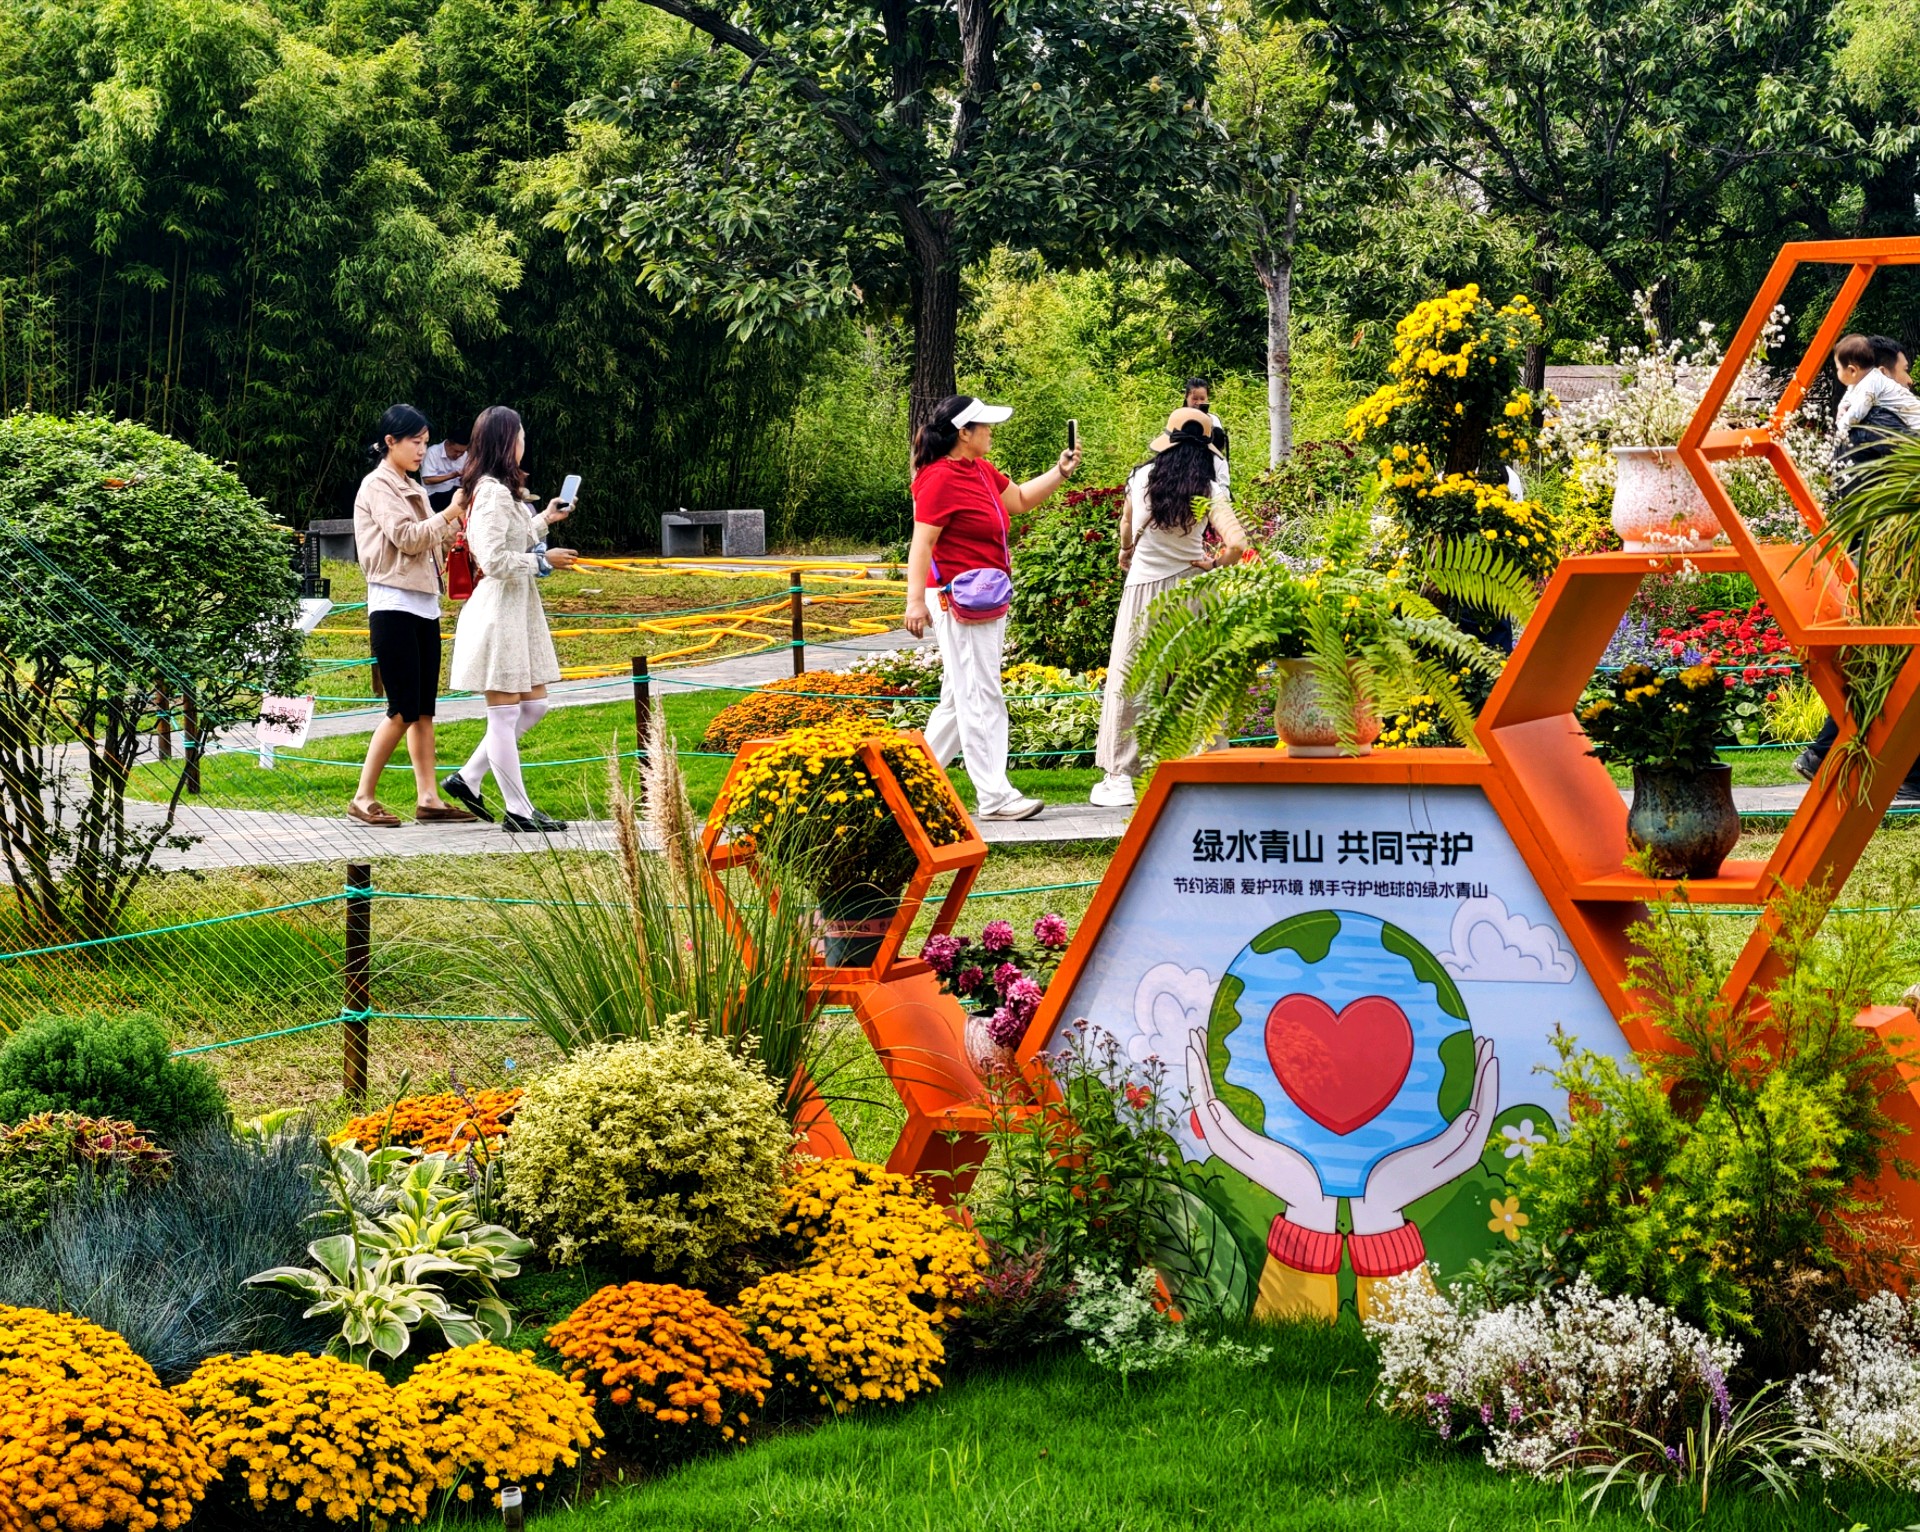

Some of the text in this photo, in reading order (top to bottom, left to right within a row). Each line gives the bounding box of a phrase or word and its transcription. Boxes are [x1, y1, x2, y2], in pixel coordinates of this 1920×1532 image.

[1193, 829, 1473, 866] 绿水青山 共同守护
[1173, 877, 1488, 899] 节约资源 爱护环境 携手守护地球的绿水青山
